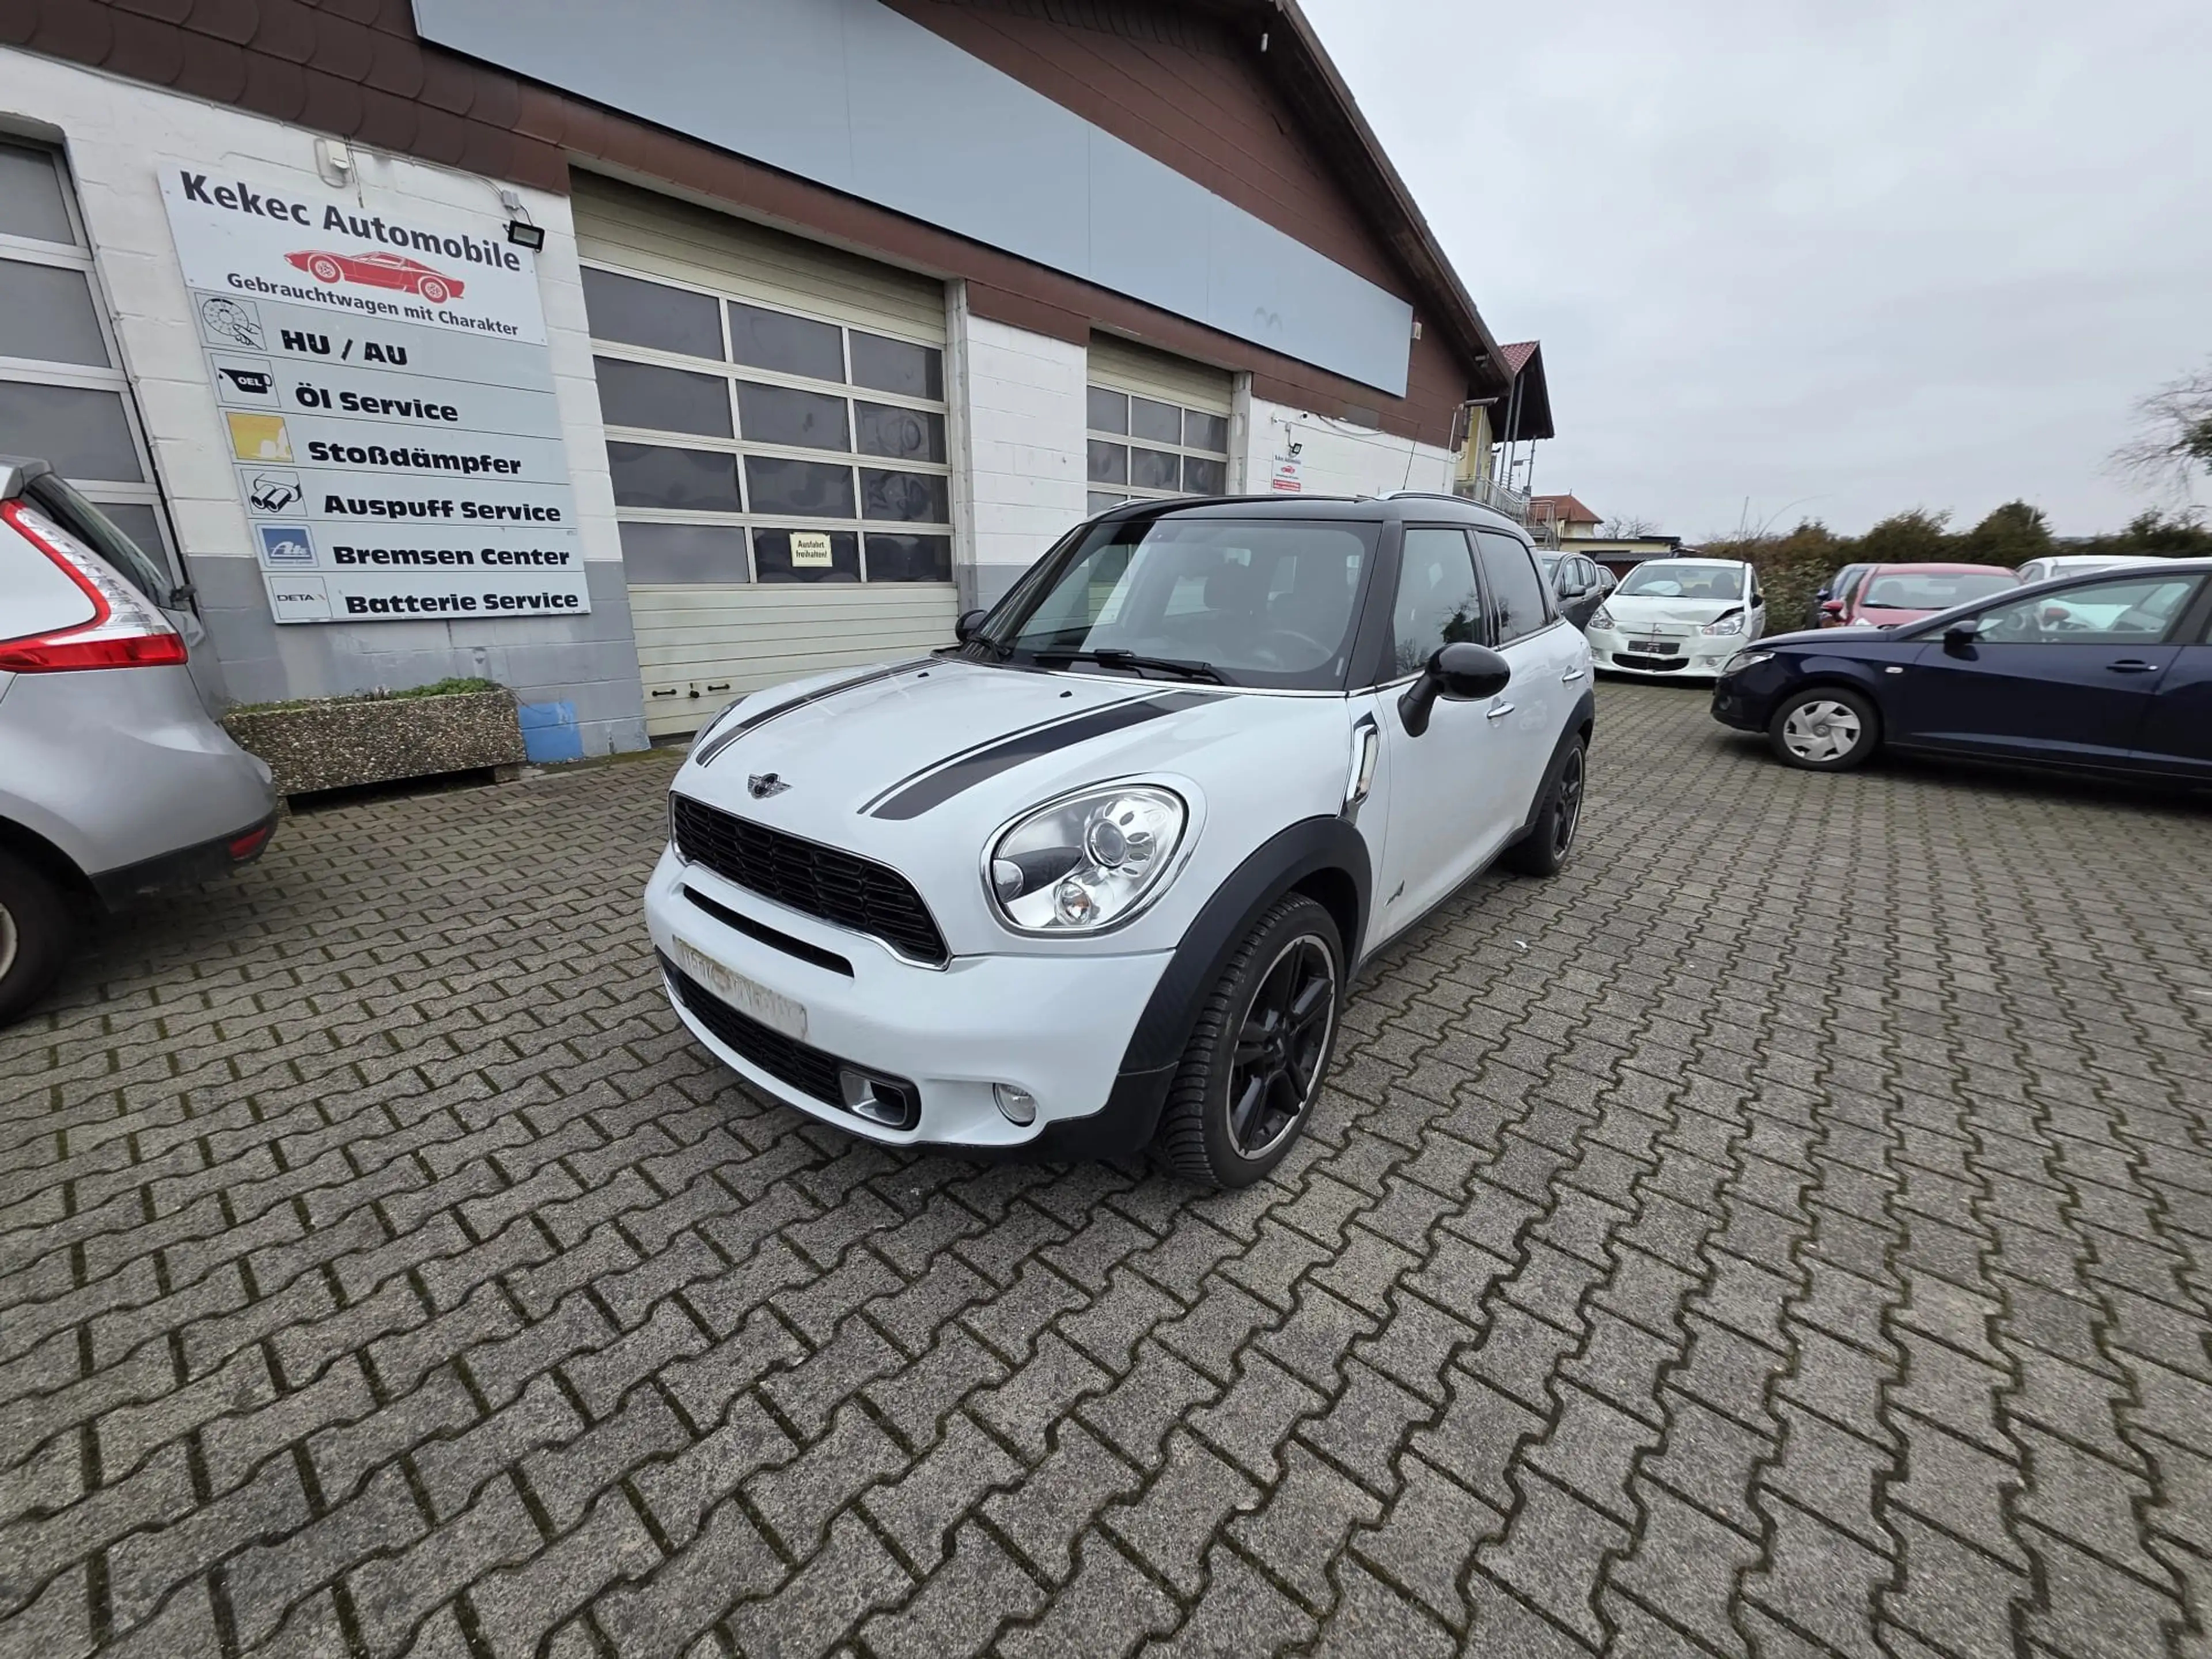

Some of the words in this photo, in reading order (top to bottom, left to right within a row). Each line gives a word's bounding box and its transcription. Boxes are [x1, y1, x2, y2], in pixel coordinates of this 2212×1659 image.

[179, 171, 310, 226] Kekec
[323, 205, 521, 271] Automobile
[227, 272, 398, 316] Gebrauchtwagen
[403, 307, 433, 323] mit
[438, 312, 518, 336] Charakter
[281, 329, 331, 355] HU
[340, 339, 353, 360] /
[363, 341, 407, 366] AU
[237, 376, 263, 387] OEL
[296, 382, 332, 409] Öl
[339, 392, 458, 422] Service
[308, 441, 522, 474] Stoßdämpfer
[324, 495, 453, 518] Auspuff
[460, 501, 561, 521] Service
[332, 546, 474, 565] Bremsen
[480, 548, 569, 565] Center
[345, 594, 476, 614] Batterie
[483, 593, 578, 611] Service
